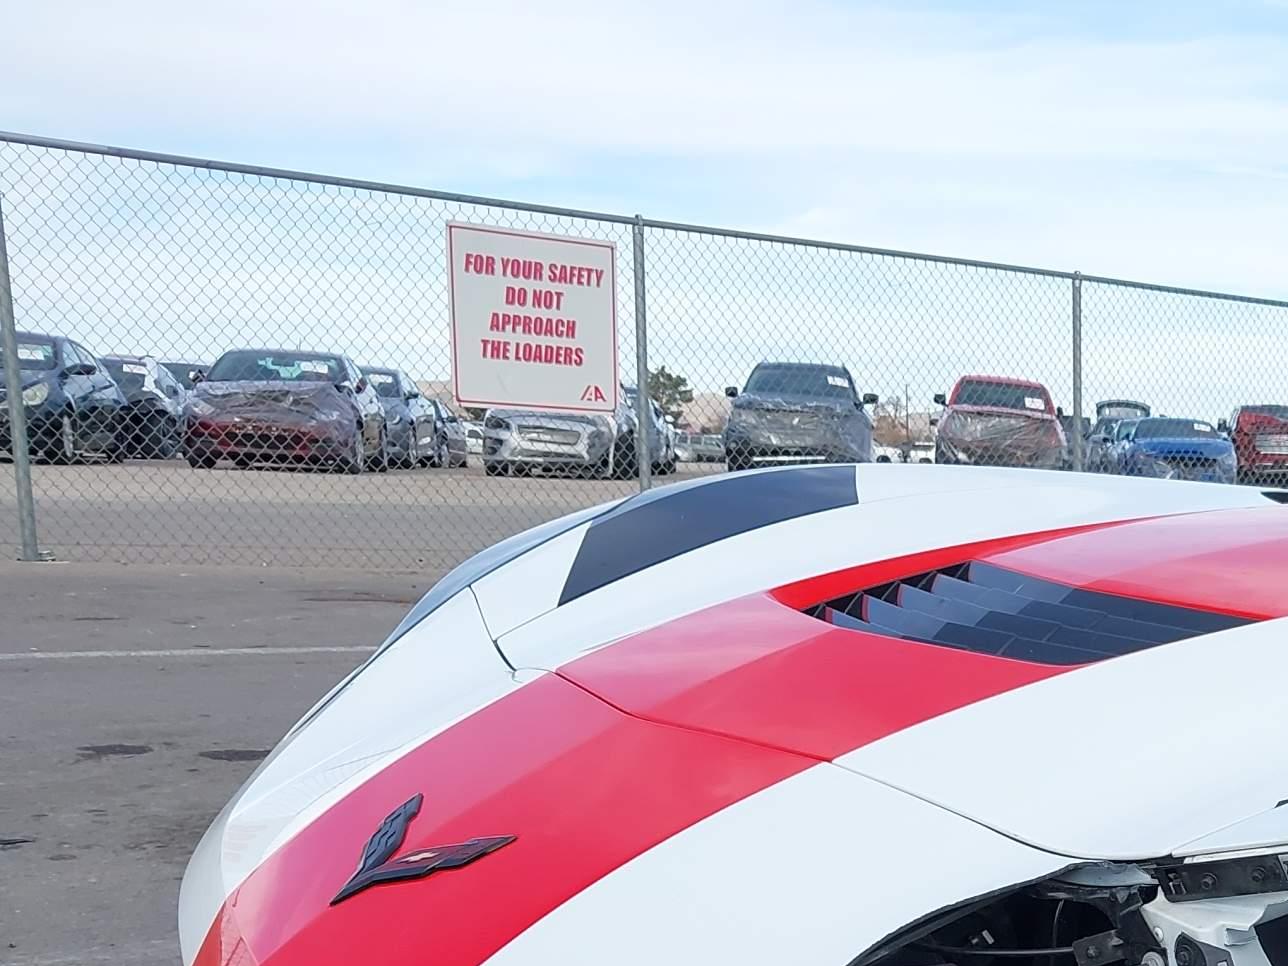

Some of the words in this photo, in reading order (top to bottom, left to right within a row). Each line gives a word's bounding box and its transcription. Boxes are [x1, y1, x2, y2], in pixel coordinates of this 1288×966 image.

[464, 253, 495, 276] FOR
[501, 257, 544, 281] YOUR
[548, 263, 604, 288] SAFETY
[505, 286, 527, 307] DO
[532, 289, 564, 311] NOT
[489, 312, 577, 339] APPROACH
[480, 339, 511, 361] THE
[514, 342, 584, 367] LOADERS
